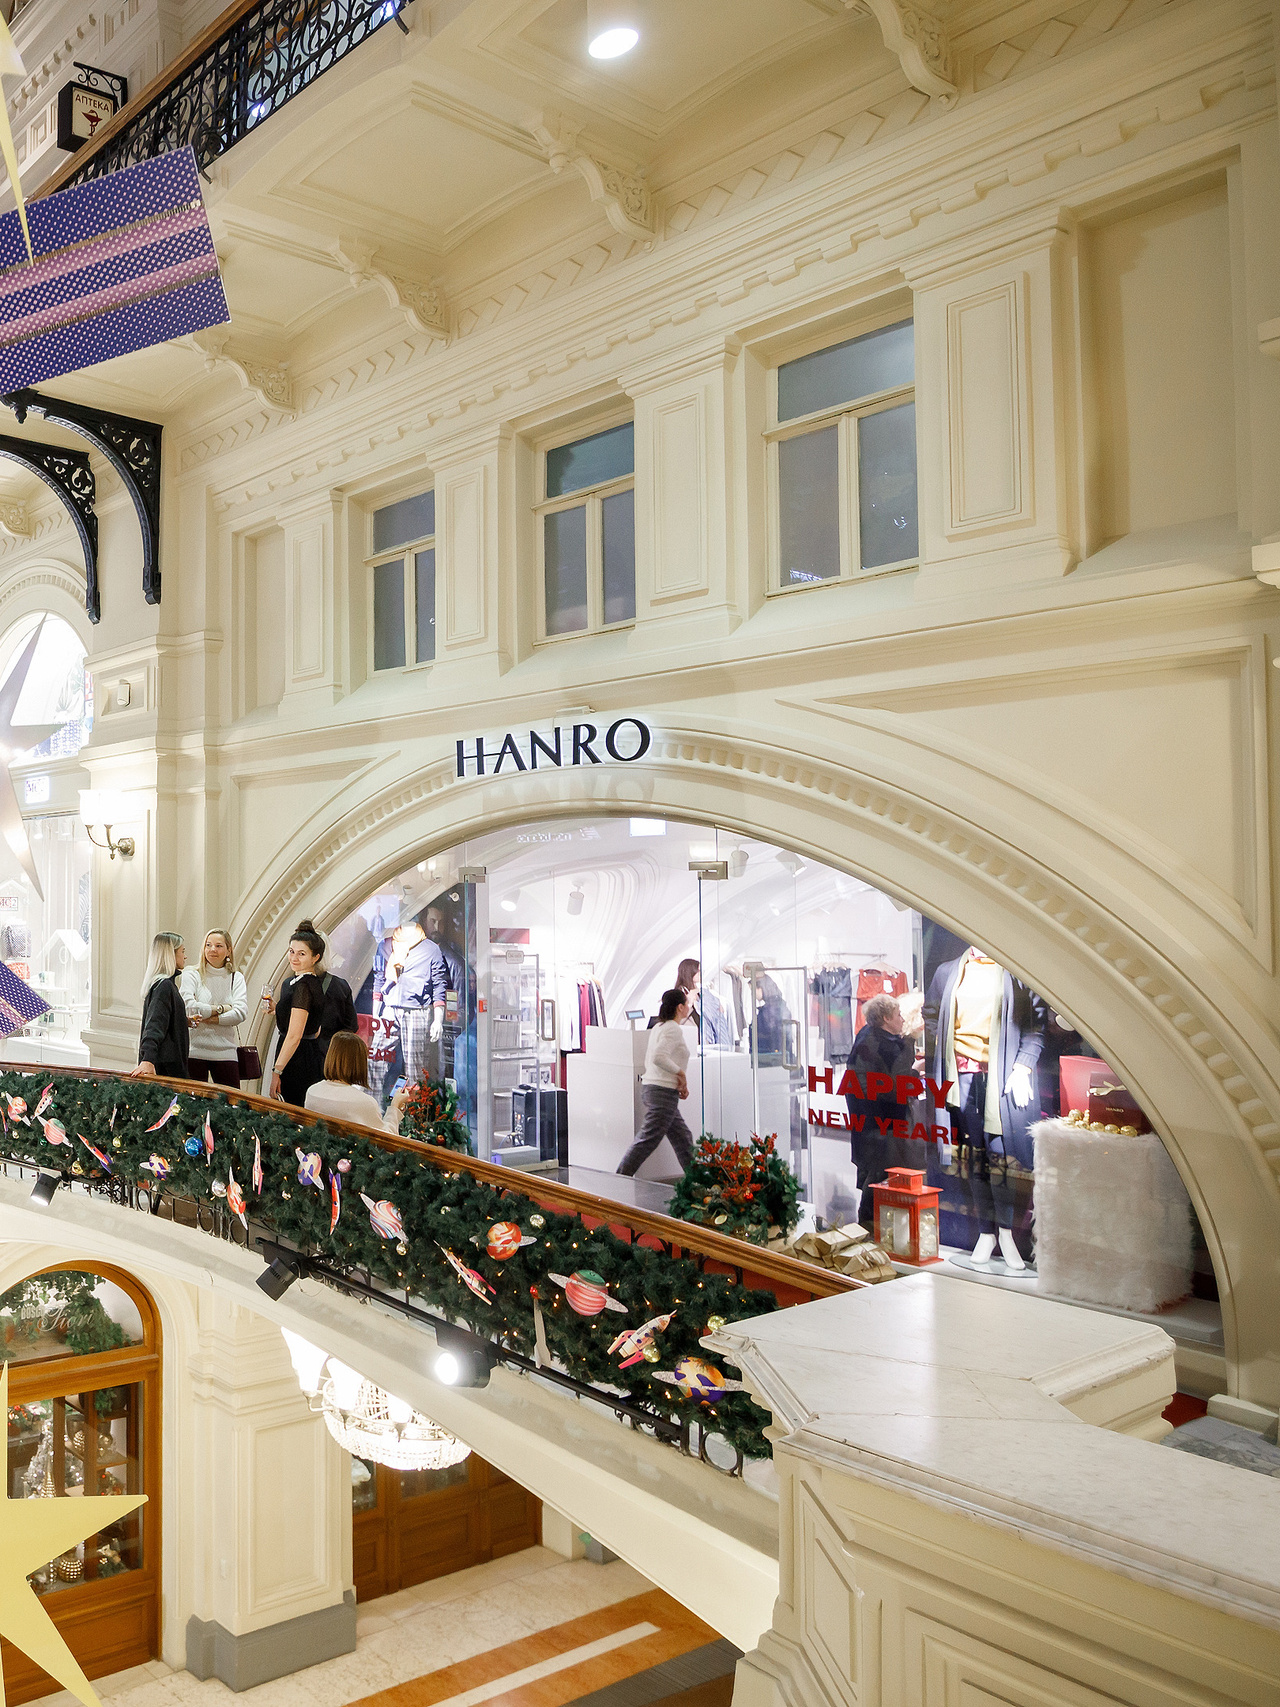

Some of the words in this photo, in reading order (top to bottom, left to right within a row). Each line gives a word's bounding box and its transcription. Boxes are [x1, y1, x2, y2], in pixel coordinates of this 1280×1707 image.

[75, 93, 110, 113] АПТЕКА
[456, 717, 651, 778] HANRO
[808, 1065, 955, 1109] HAPPY
[808, 1108, 866, 1132] NEW
[874, 1116, 959, 1145] YEAR!
